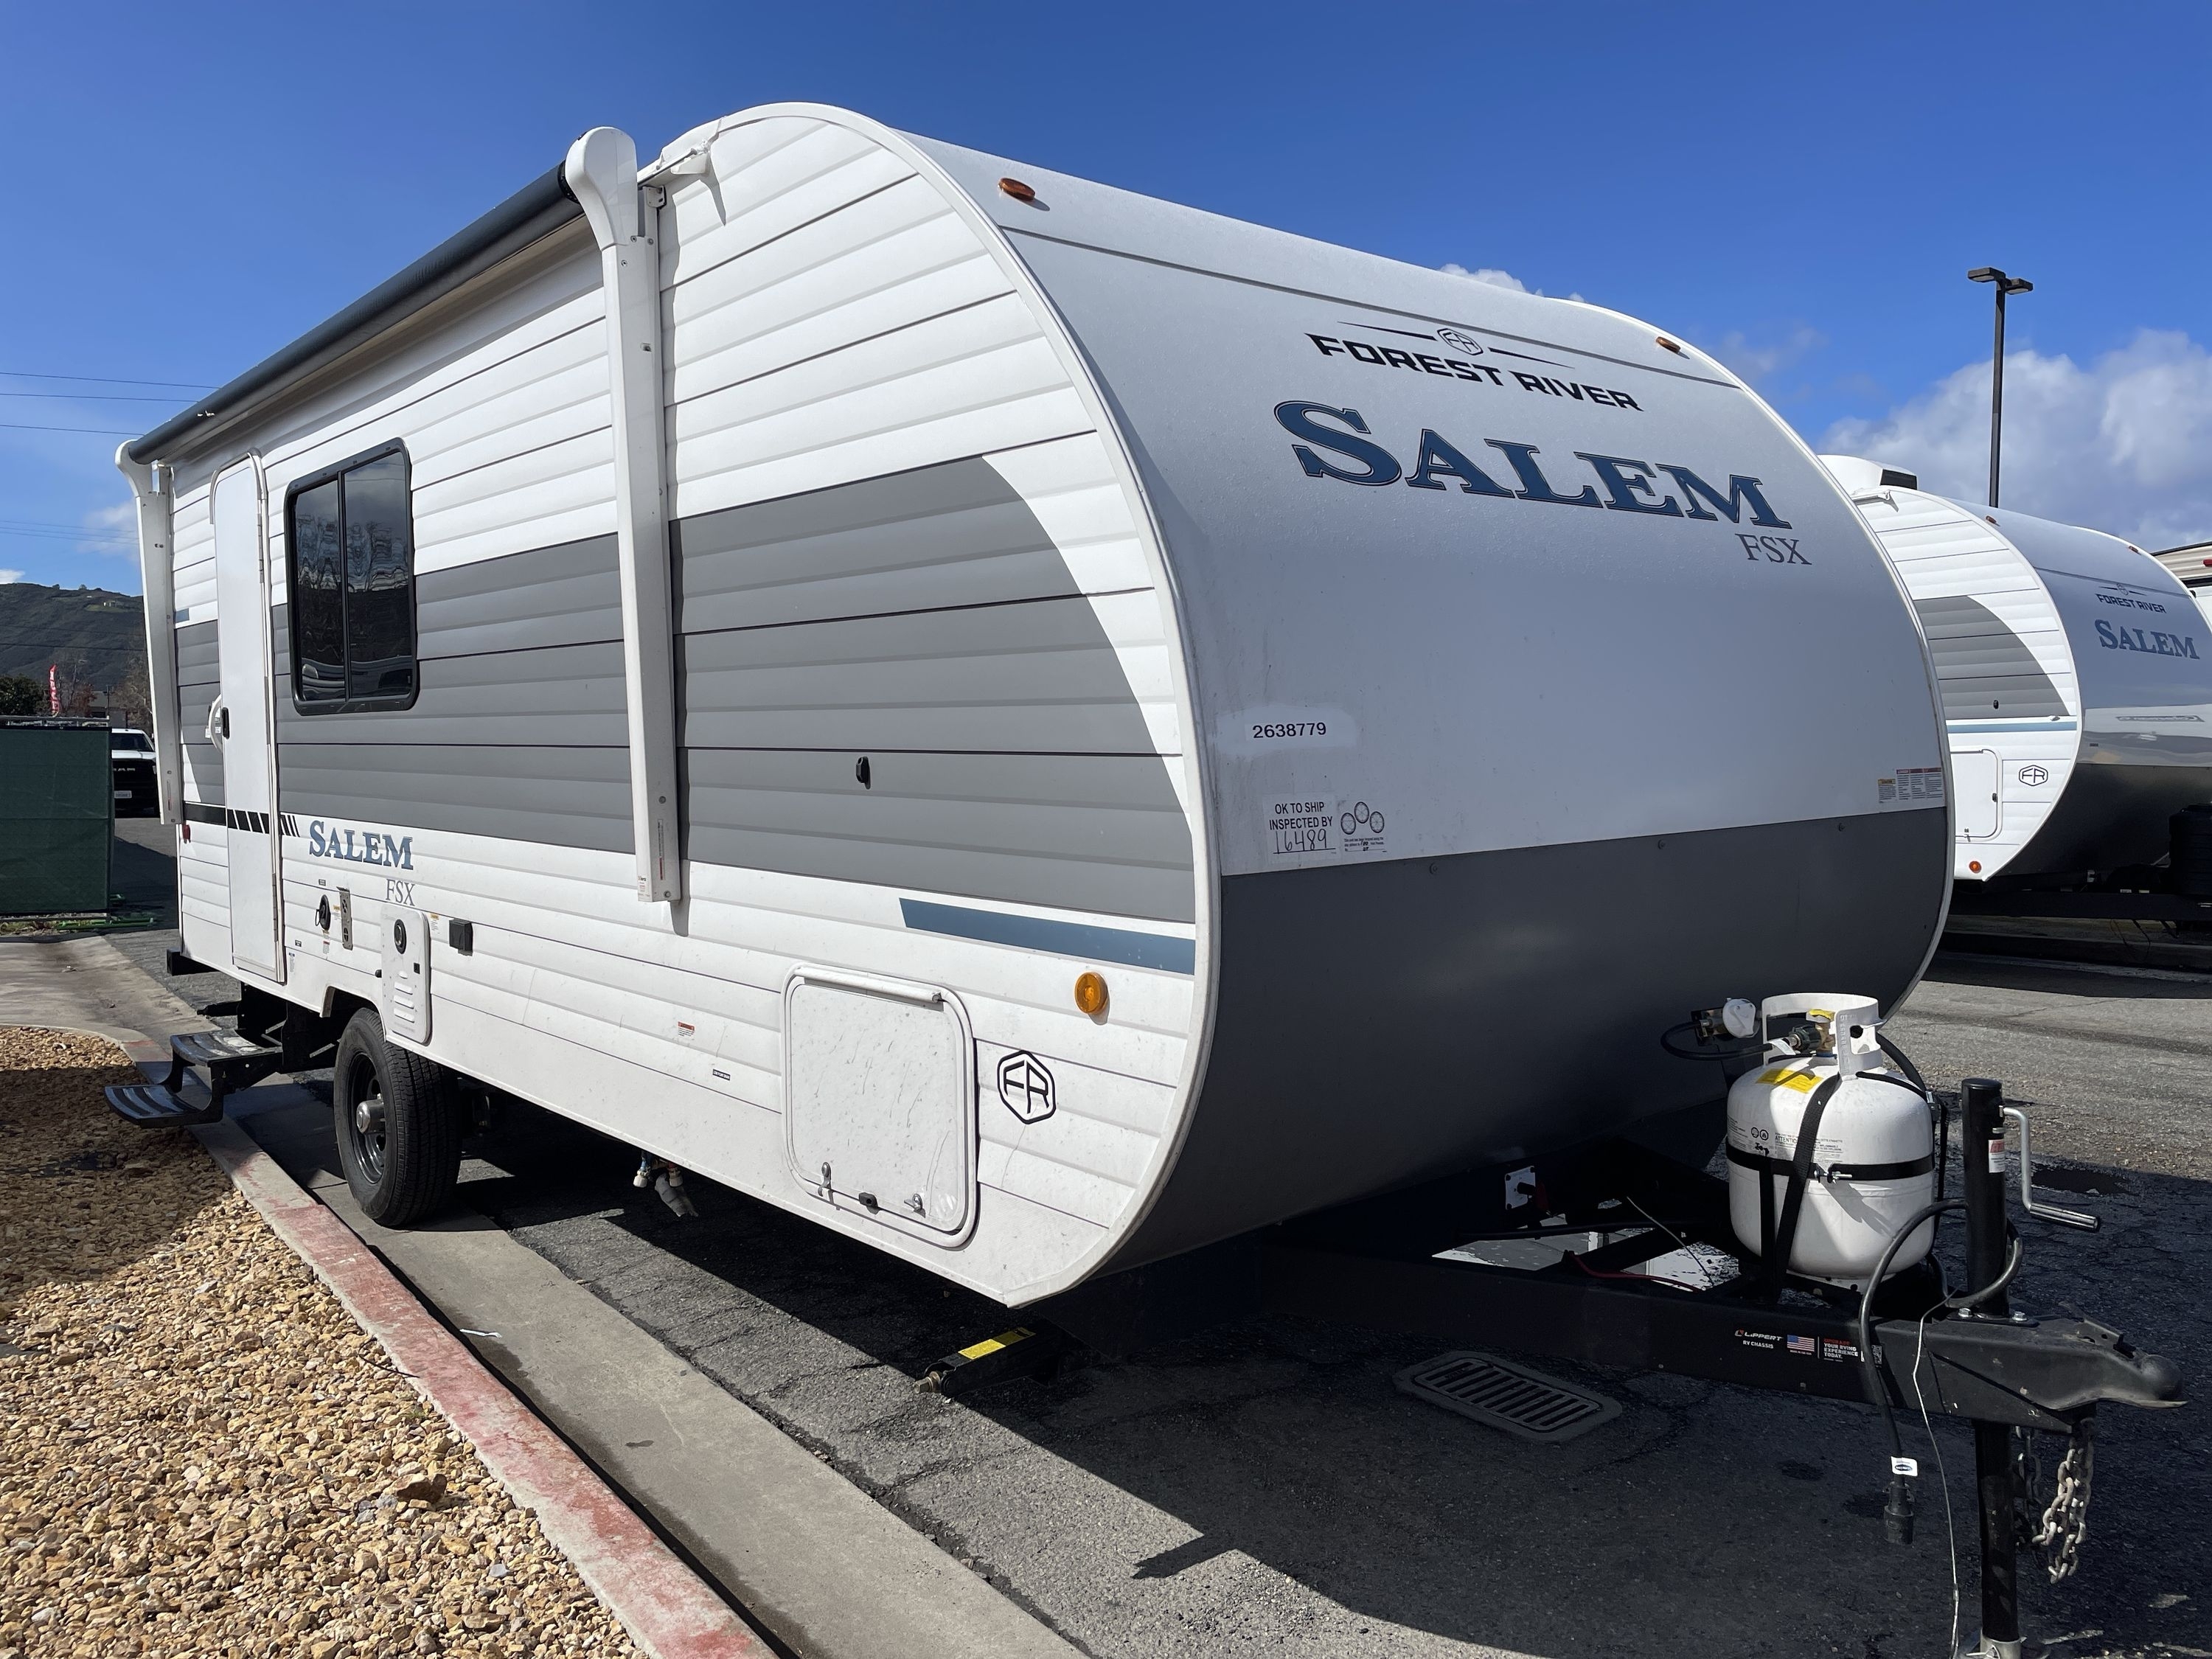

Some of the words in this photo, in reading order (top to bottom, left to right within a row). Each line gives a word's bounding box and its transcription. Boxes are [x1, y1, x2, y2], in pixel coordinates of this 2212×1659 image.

[1304, 333, 1503, 386] FOREST
[1513, 371, 1644, 411] RIVER
[1273, 400, 1792, 530] SALEM
[1735, 533, 1812, 566] FSX
[2095, 593, 2136, 608] FOREST
[2138, 600, 2167, 613] RIVER
[2095, 619, 2200, 659] SALEM
[1252, 722, 1327, 738] 2638779
[1275, 804, 1289, 814] OK
[1290, 803, 1303, 813] TO
[1304, 801, 1324, 813] SHIP
[1269, 817, 1319, 830] INSPECTED
[1321, 816, 1333, 827] BY
[309, 820, 414, 871] SALEM
[1276, 829, 1327, 854] 16489
[386, 878, 415, 906] FSX
[1775, 1135, 1798, 1144] ATTENTIO
[1745, 1332, 1783, 1341] LIPPERT
[1750, 1341, 1774, 1349] CHASSIS
[1823, 1347, 1859, 1357] EXPERIENCE
